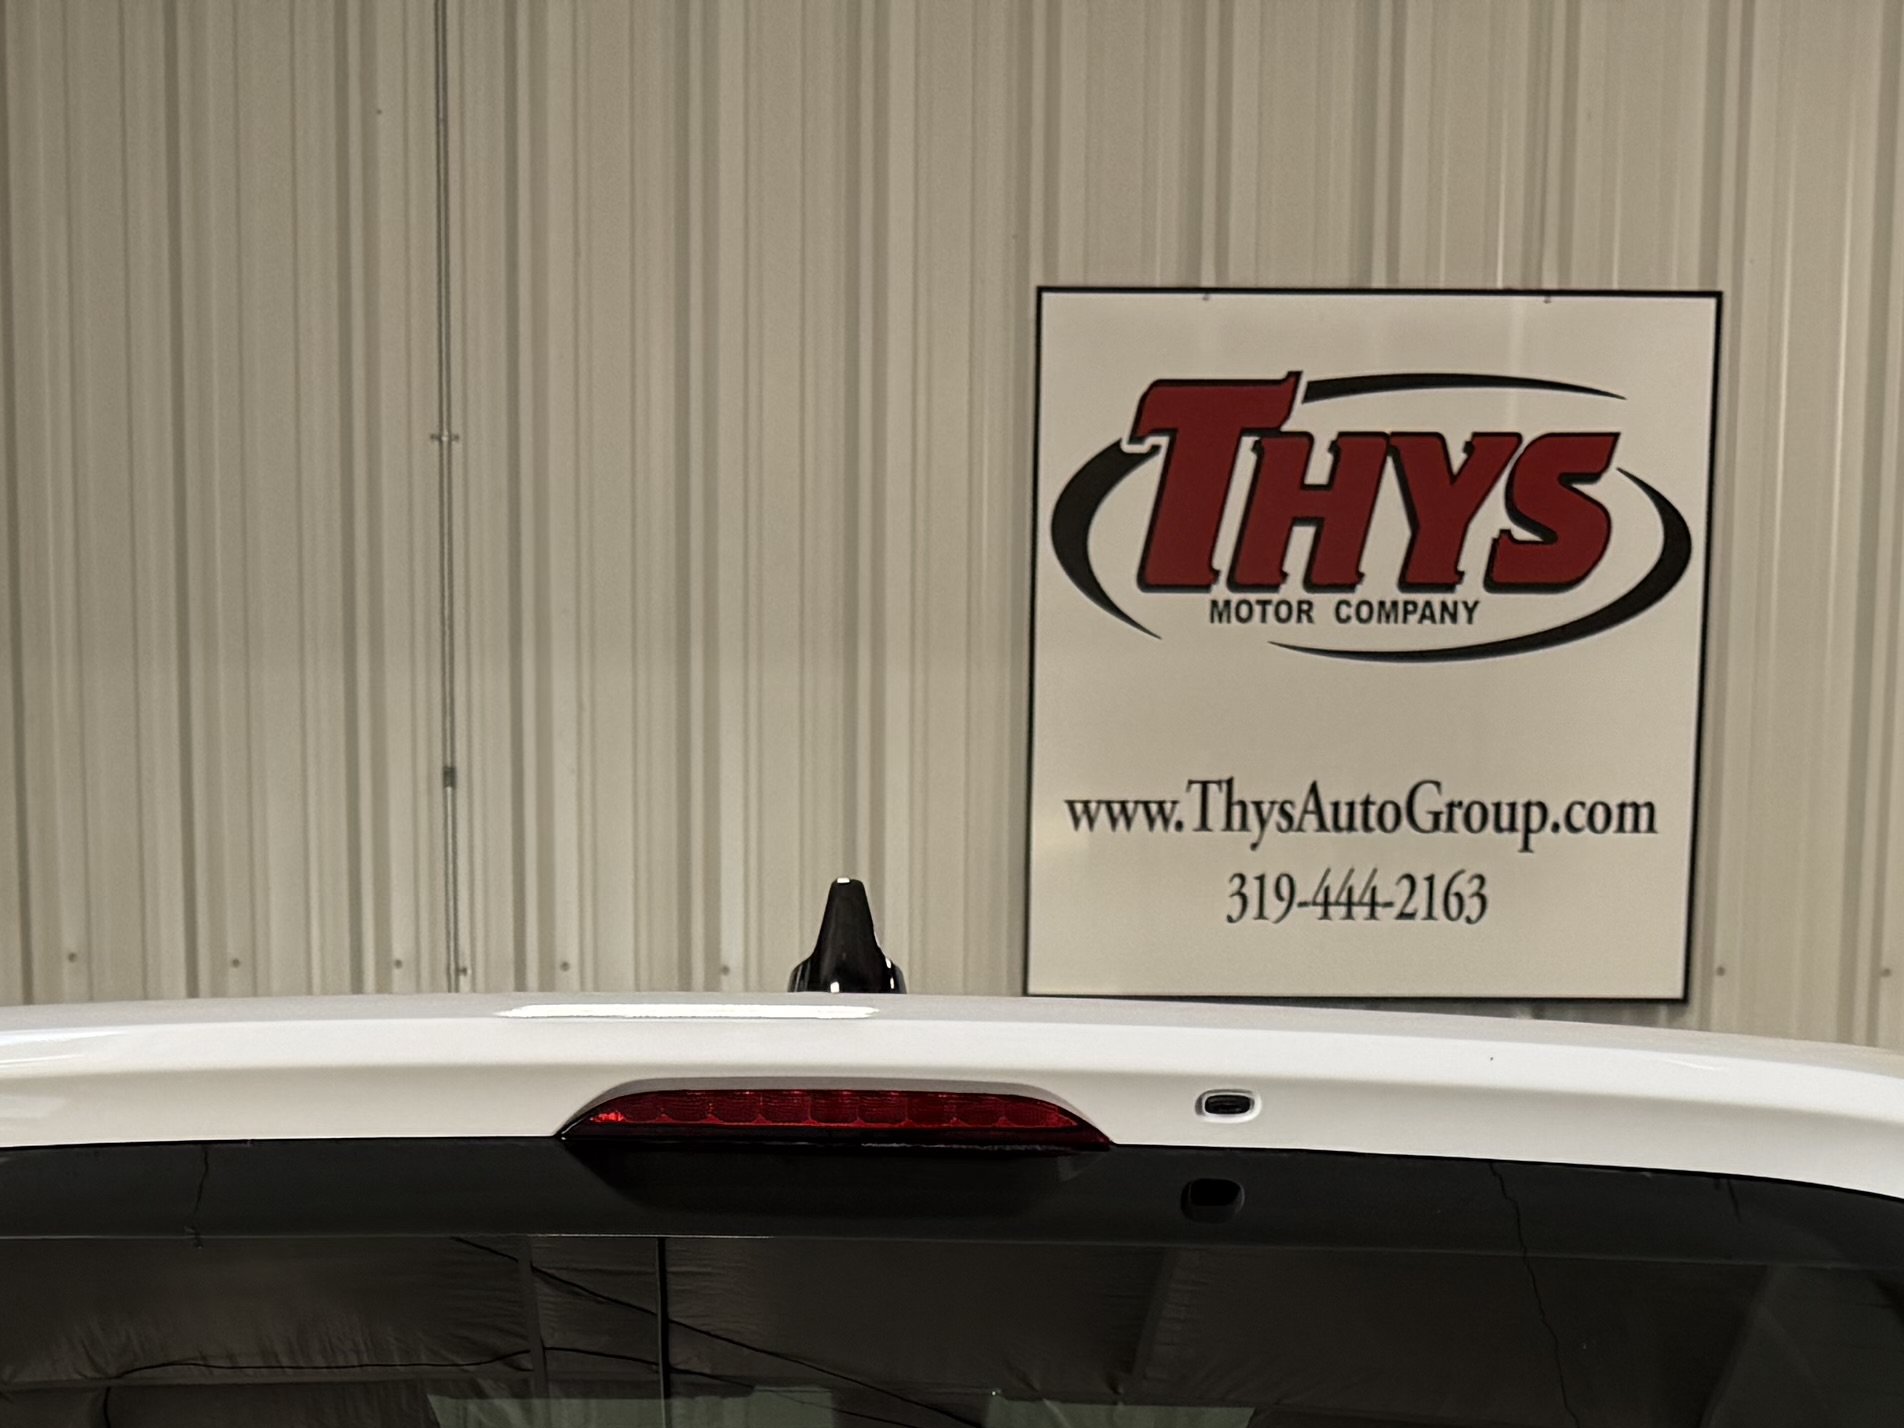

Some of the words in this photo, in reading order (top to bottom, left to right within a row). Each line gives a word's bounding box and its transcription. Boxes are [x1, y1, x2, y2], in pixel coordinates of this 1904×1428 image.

[1128, 370, 1621, 593] THYS
[1209, 599, 1316, 625] MOTOR
[1334, 599, 1481, 626] COMPANY
[1064, 777, 1658, 853] www.ThysAutoGroup.com
[1226, 867, 1489, 925] 319-444-2163
